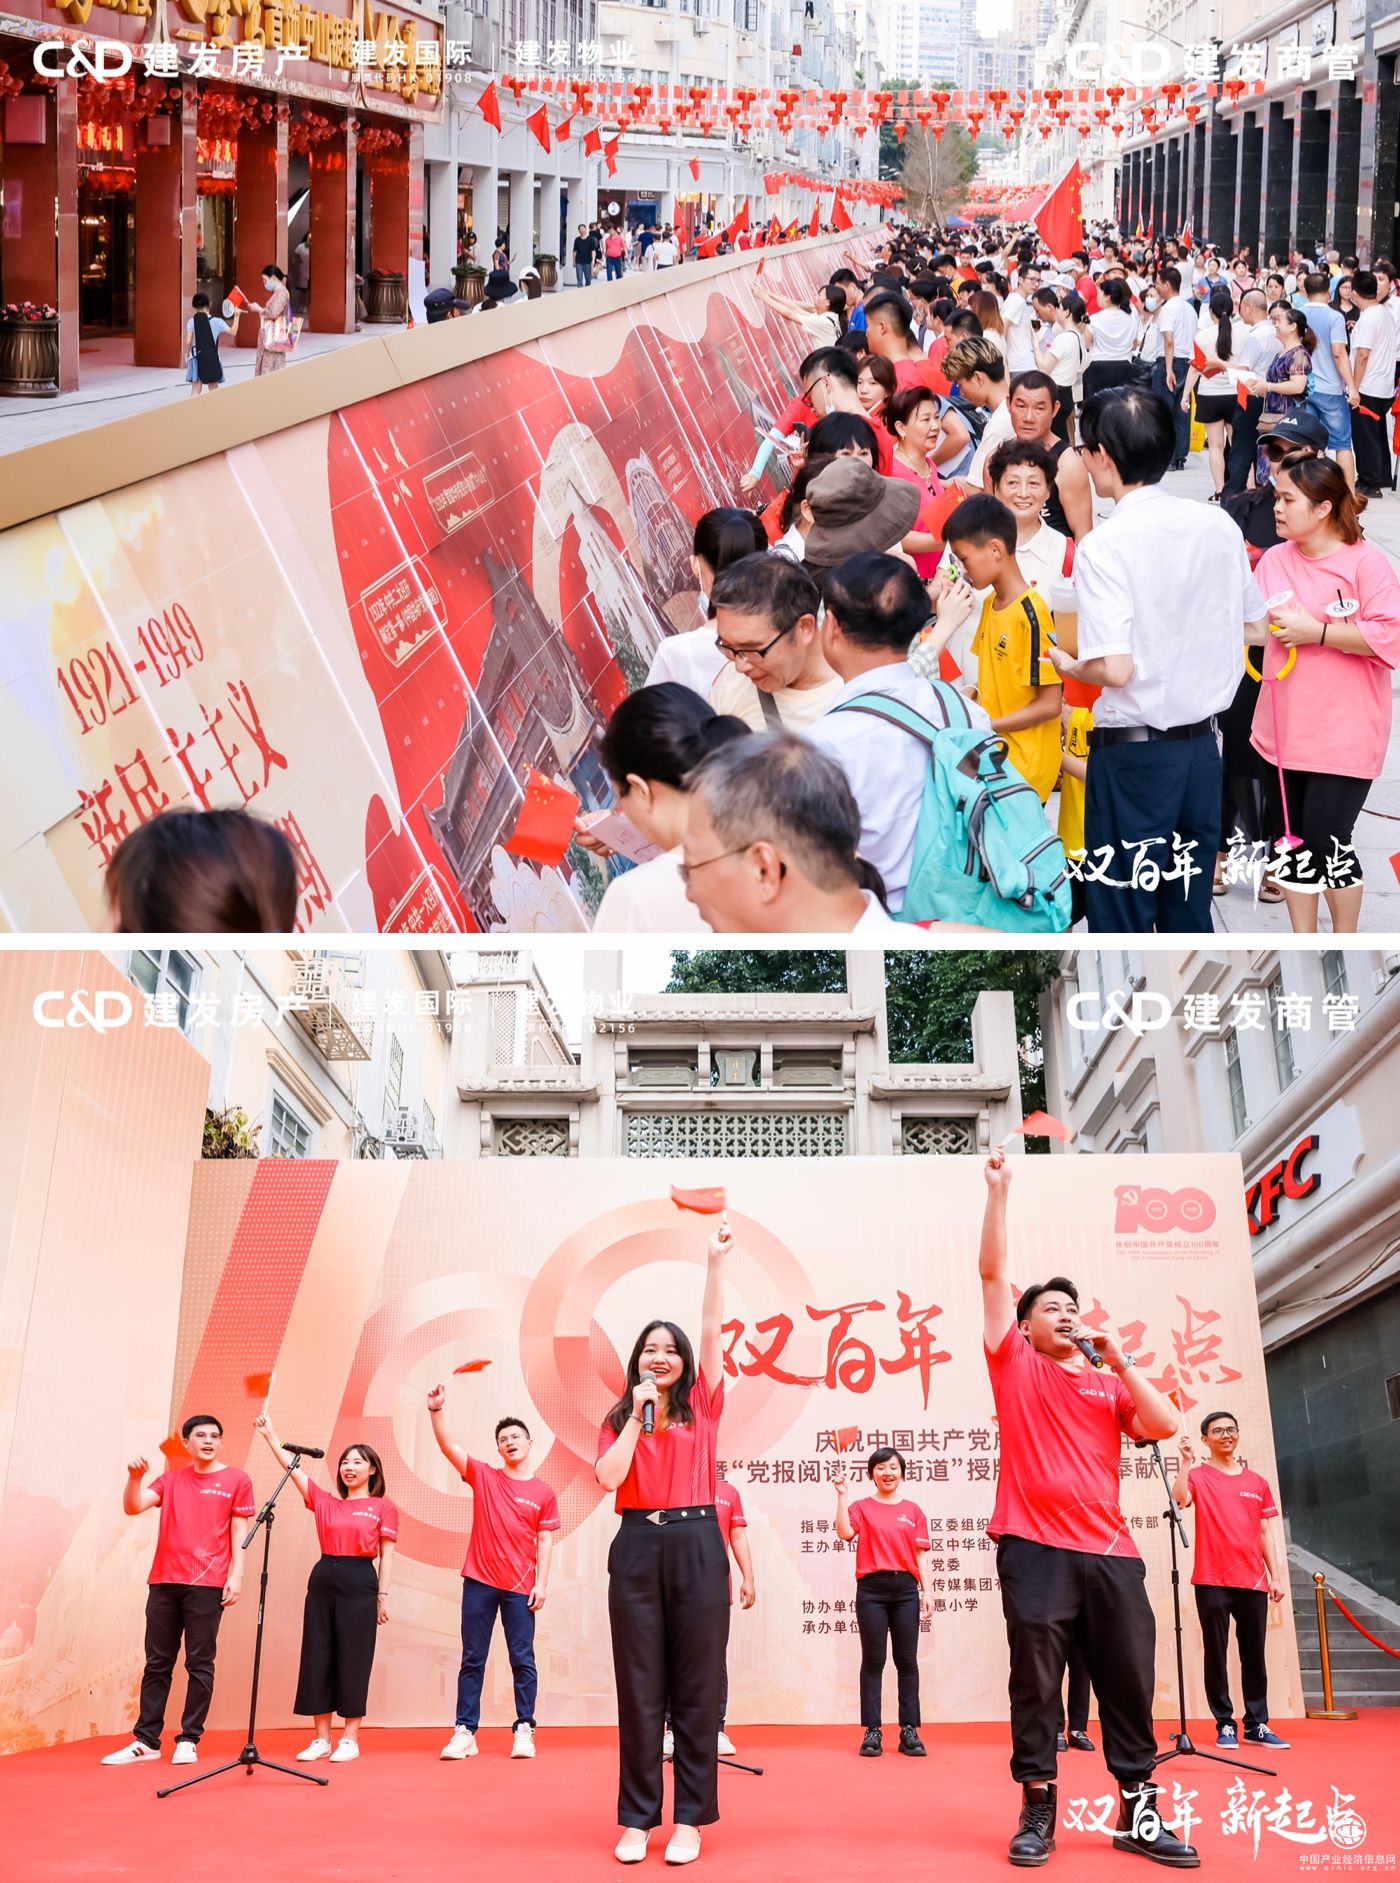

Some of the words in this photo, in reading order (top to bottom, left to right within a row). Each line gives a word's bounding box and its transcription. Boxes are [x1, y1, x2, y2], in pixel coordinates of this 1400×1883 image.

[57, 602, 204, 735] 1921-1949
[399, 882, 440, 933] 年中共一大召开
[1244, 1135, 1321, 1236] KFC
[721, 1289, 953, 1410] 双百年
[815, 1428, 1000, 1453] 庆祝中国共产党
[716, 1458, 1000, 1484] 暨“党报阅读示街道”授
[800, 1519, 838, 1534] 指导
[930, 1518, 990, 1532] 区委组织
[1124, 1516, 1159, 1530] 传部
[931, 1538, 999, 1552] 区中华街
[931, 1558, 961, 1573] 党委
[919, 1598, 979, 1613] 惠小学
